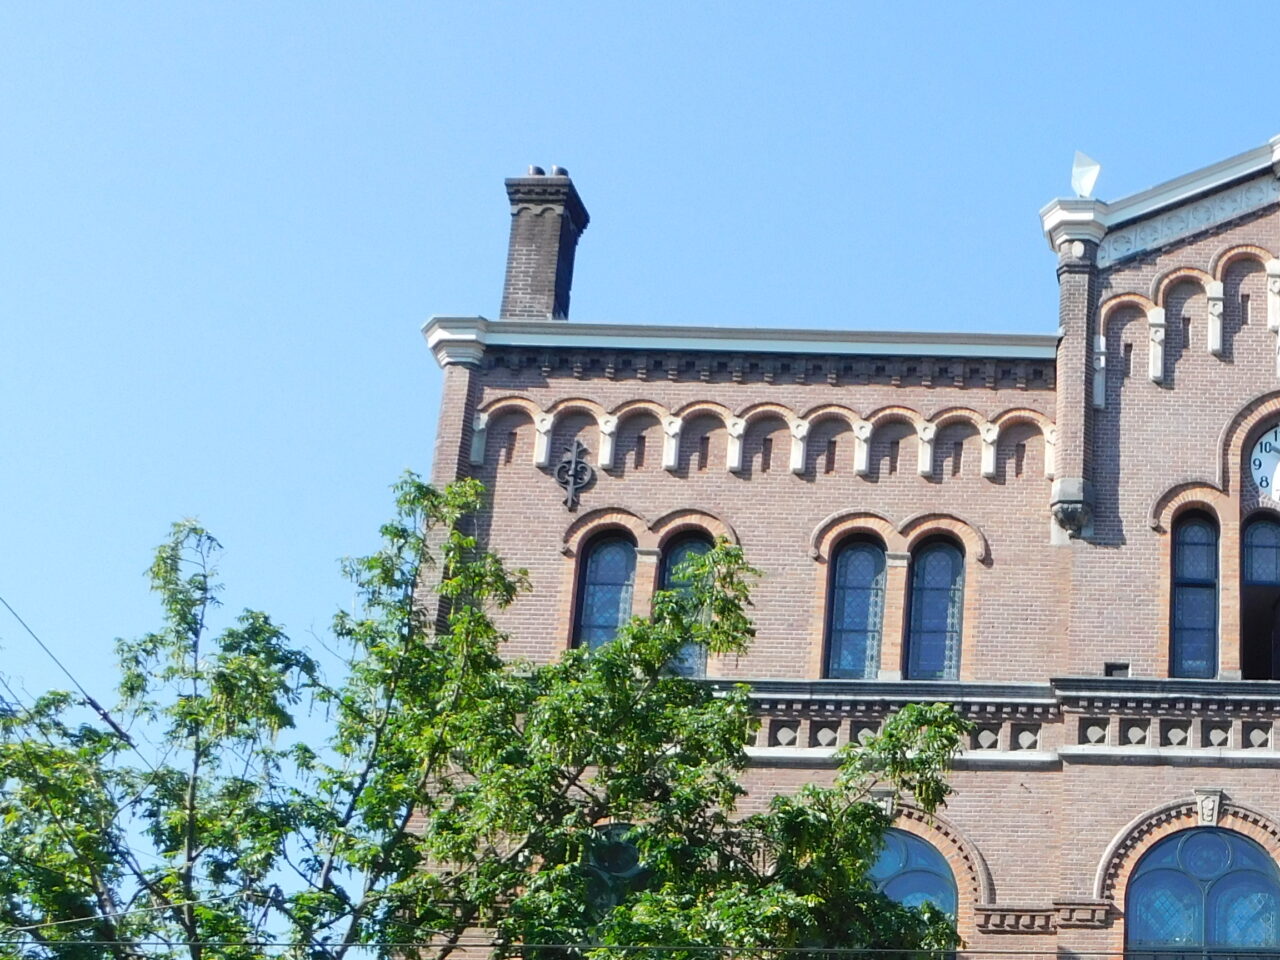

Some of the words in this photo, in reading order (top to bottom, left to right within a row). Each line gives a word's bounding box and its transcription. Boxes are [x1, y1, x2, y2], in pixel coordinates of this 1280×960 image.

[1259, 441, 1273, 454] 10
[1253, 458, 1262, 470] 9
[1259, 476, 1269, 489] 8
